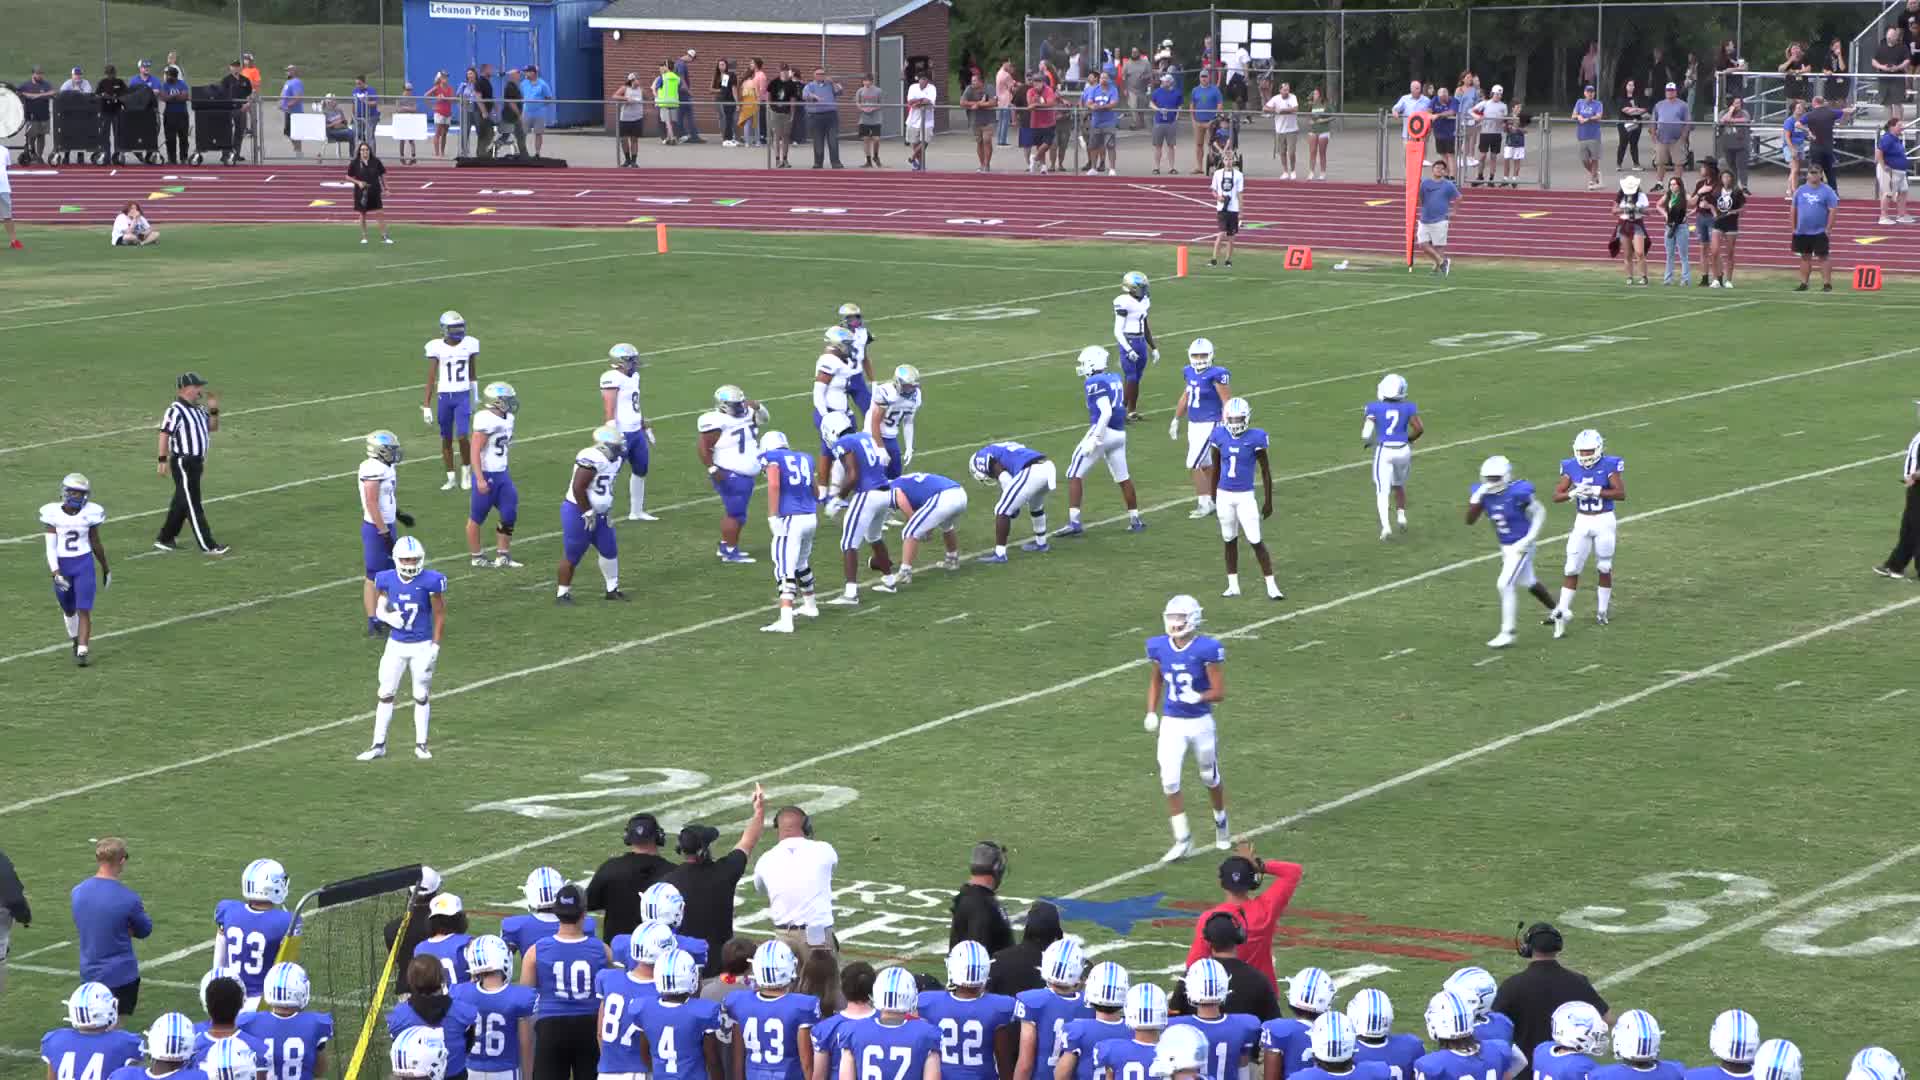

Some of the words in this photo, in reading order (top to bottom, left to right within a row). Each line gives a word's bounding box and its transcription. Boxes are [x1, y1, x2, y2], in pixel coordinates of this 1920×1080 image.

[430, 3, 471, 16] Lebanon
[474, 6, 501, 17] Pride
[503, 7, 528, 19] Shop
[1288, 249, 1304, 267] G
[1857, 268, 1876, 288] 10
[446, 359, 466, 382] 12
[1385, 409, 1400, 436] 7
[784, 455, 811, 486] 54
[1227, 456, 1236, 478] 1
[65, 530, 79, 552] 2
[225, 926, 267, 975] 23
[552, 959, 592, 1000] 10
[657, 1025, 678, 1073] 4
[743, 1016, 784, 1064] 43
[939, 1017, 984, 1066] 22
[57, 1051, 106, 1080] 44
[264, 1036, 306, 1080] 18
[861, 1044, 912, 1080] 67
